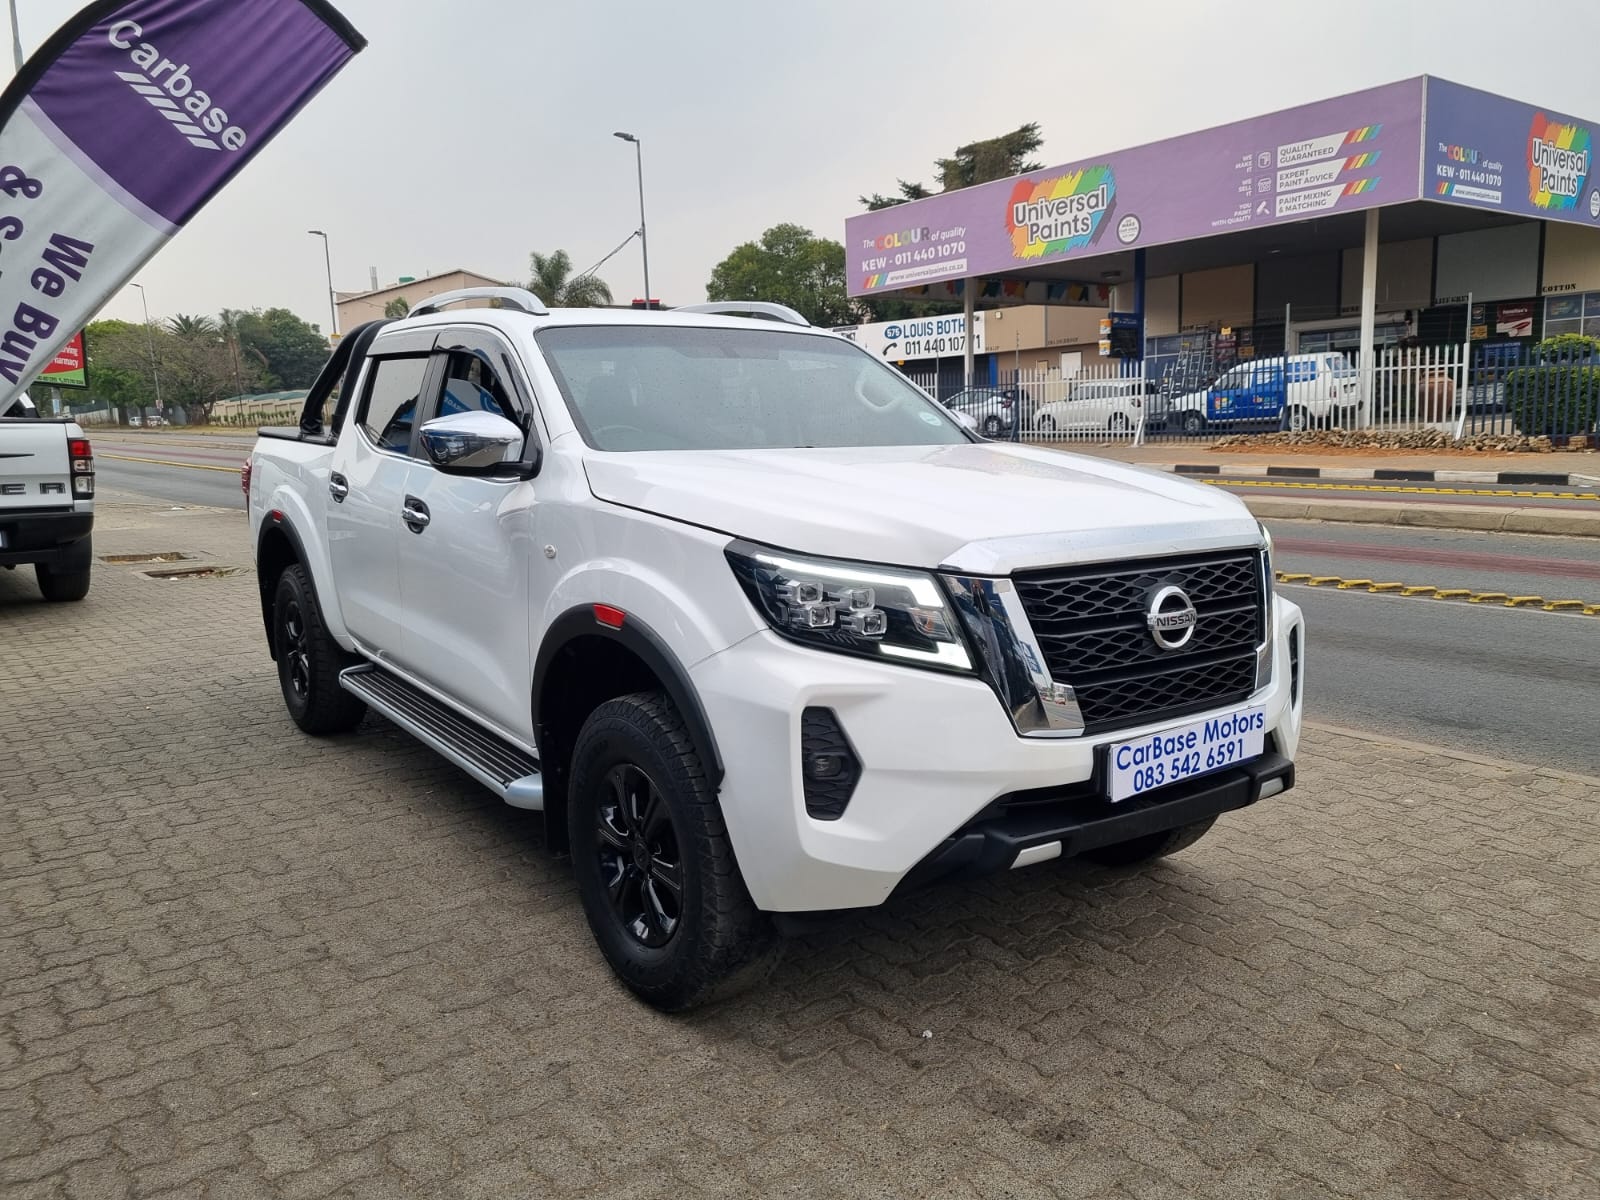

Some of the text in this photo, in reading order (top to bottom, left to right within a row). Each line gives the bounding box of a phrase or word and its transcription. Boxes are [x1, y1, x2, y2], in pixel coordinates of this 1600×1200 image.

[108, 20, 247, 151] Carbase
[1279, 142, 1314, 156] QUALITY
[1279, 146, 1335, 164] GUARANTEED
[1533, 138, 1587, 175] Universal
[1279, 168, 1309, 181] EXPERT
[1279, 172, 1334, 189] PAINT ADVICE
[1437, 164, 1455, 178] KEW
[1459, 168, 1471, 181] 011
[1471, 171, 1485, 184] 440
[1485, 173, 1502, 187] 1070
[1541, 167, 1577, 195] Paints
[1014, 185, 1106, 225] Universal
[1278, 188, 1332, 206] PAINT MIXING
[1285, 198, 1327, 212] MATCHING
[862, 226, 966, 251] The COLOUR of quality
[1029, 213, 1091, 243] Paints
[31, 232, 95, 298] We
[861, 256, 887, 273] KEW
[895, 251, 912, 266] 011
[914, 247, 935, 262] 440
[937, 240, 966, 257] 1070
[1542, 283, 1577, 293] COTTON
[887, 318, 966, 339] 575 LOUIS BOTH
[905, 340, 921, 356] 011
[924, 338, 945, 354] 440
[1156, 613, 1196, 627] NISSAN
[1116, 712, 1264, 771] CarBase Motors
[1133, 738, 1243, 792] 083 542 6591
